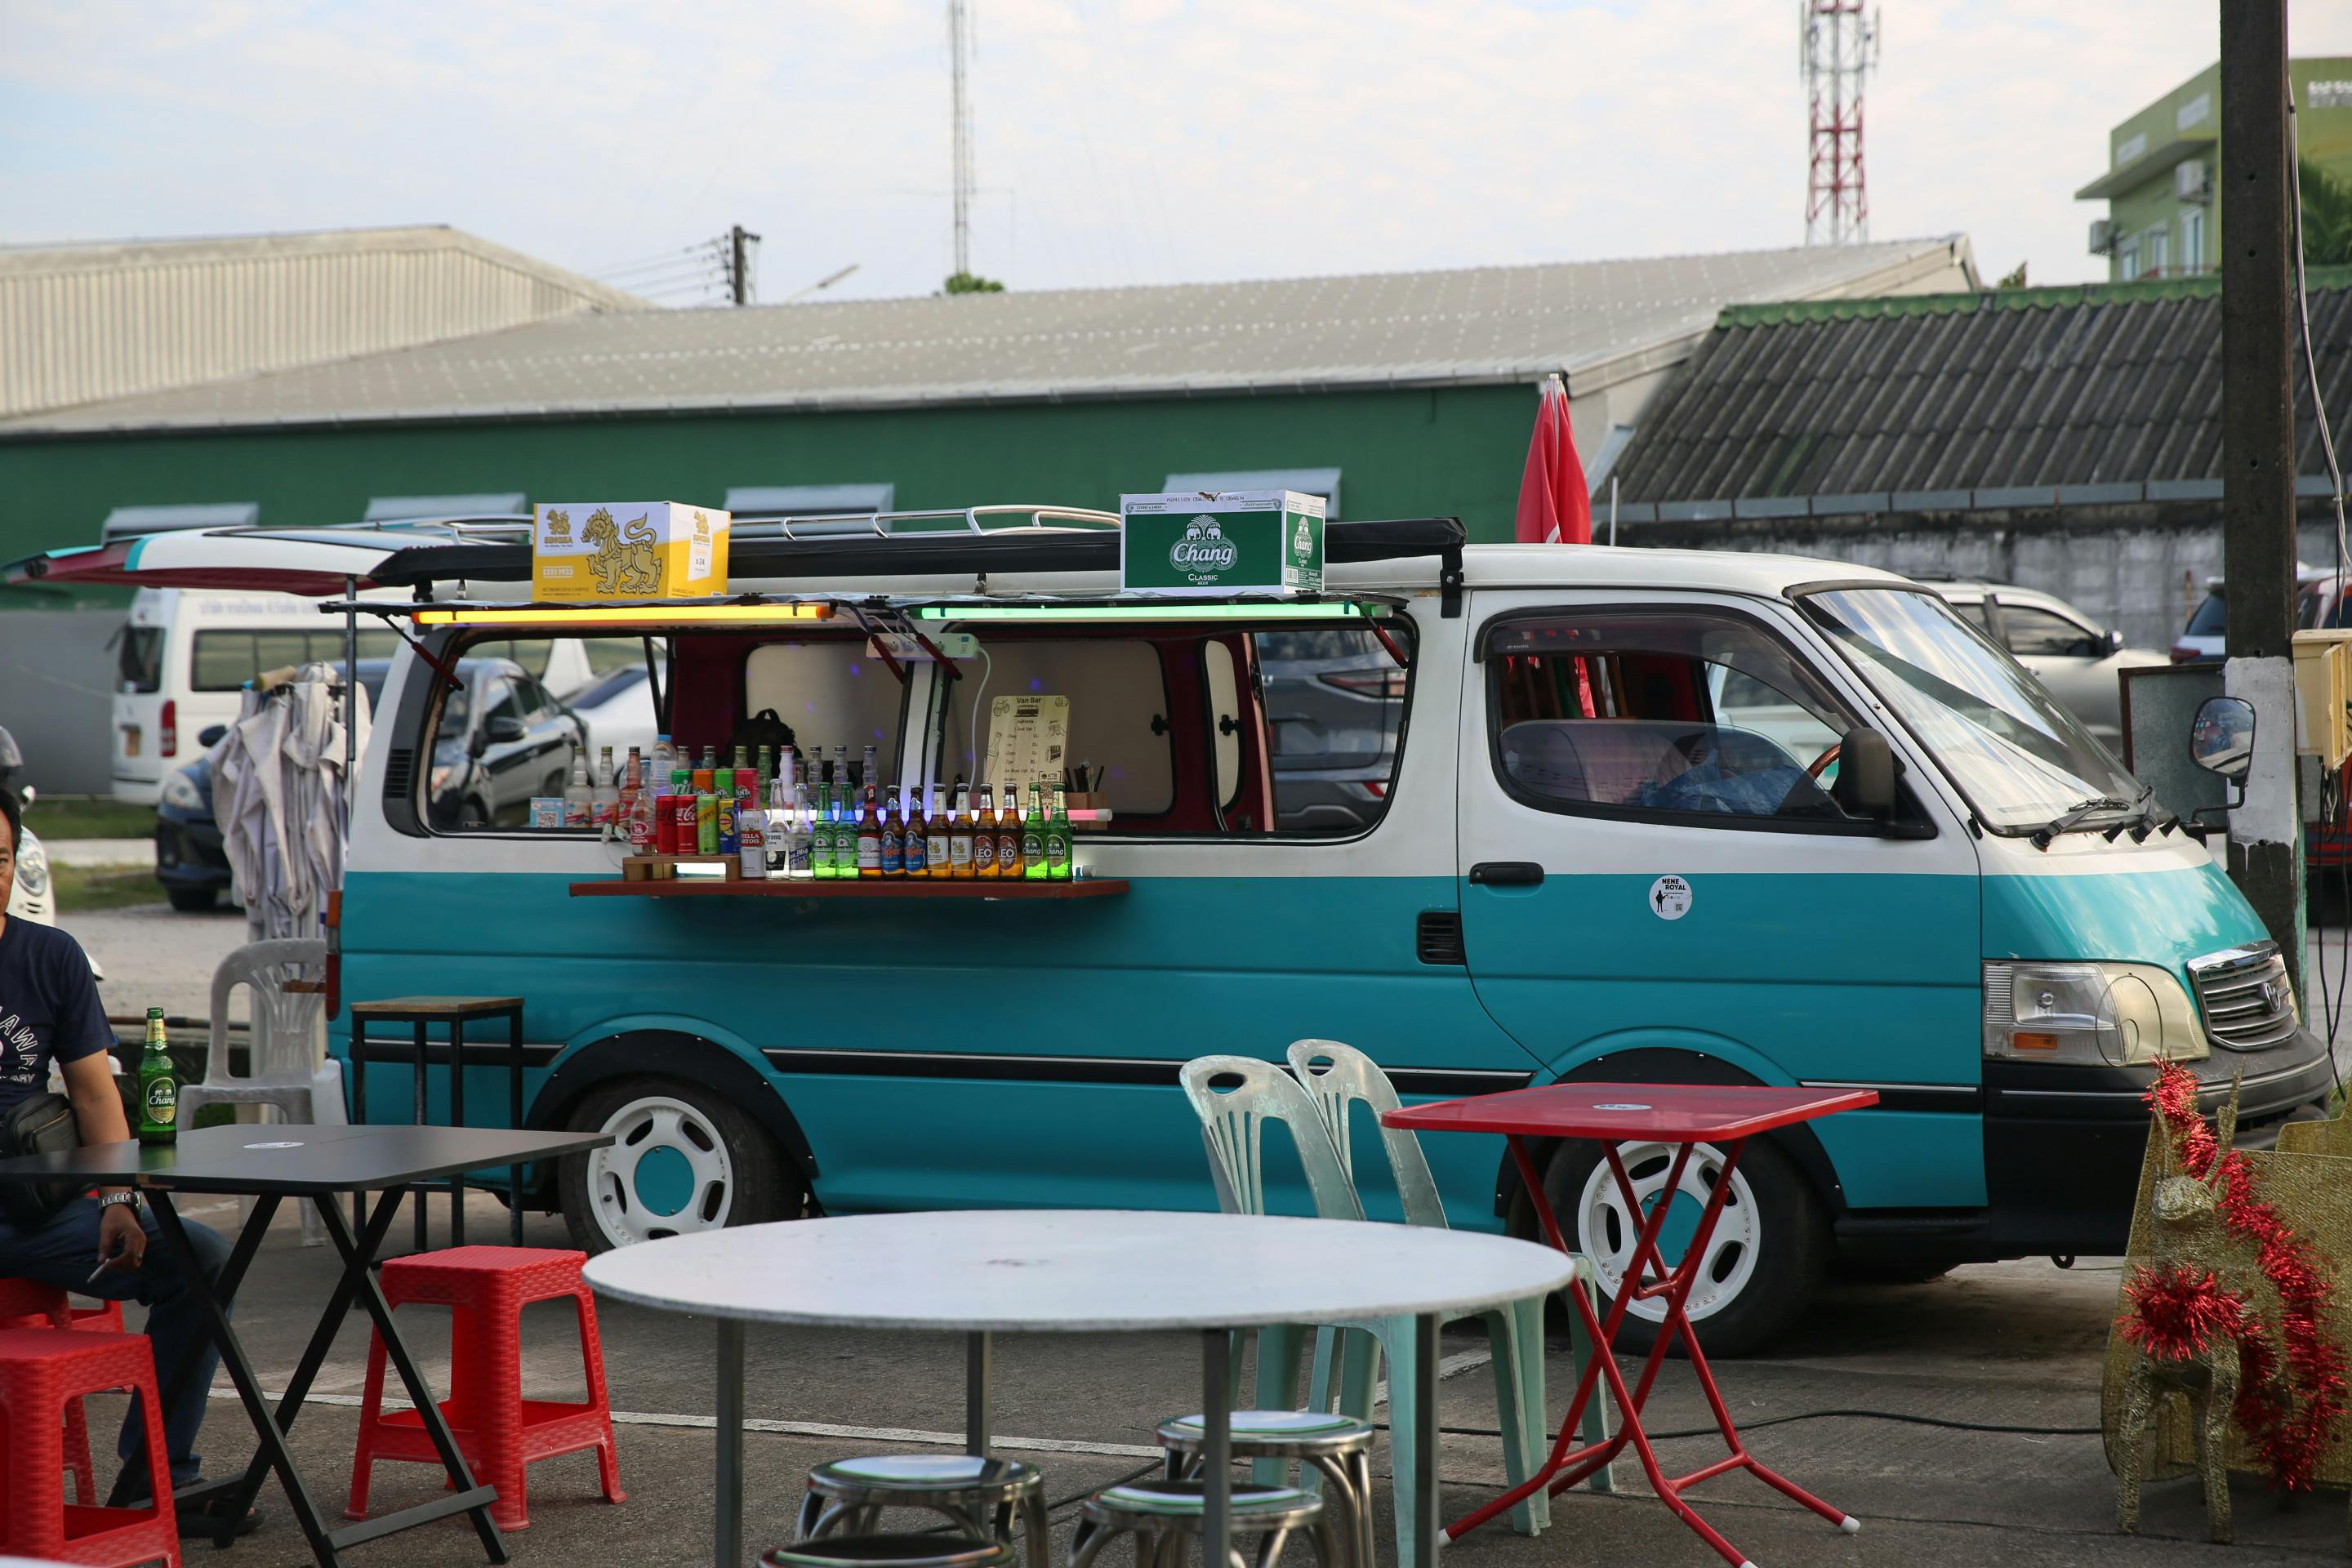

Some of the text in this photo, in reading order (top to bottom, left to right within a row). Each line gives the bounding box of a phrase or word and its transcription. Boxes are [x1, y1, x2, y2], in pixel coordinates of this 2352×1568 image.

[1294, 536, 1312, 555] Chang
[1174, 542, 1233, 565] Chang
[975, 849, 992, 858] LEO
[149, 1094, 176, 1106] Chang
